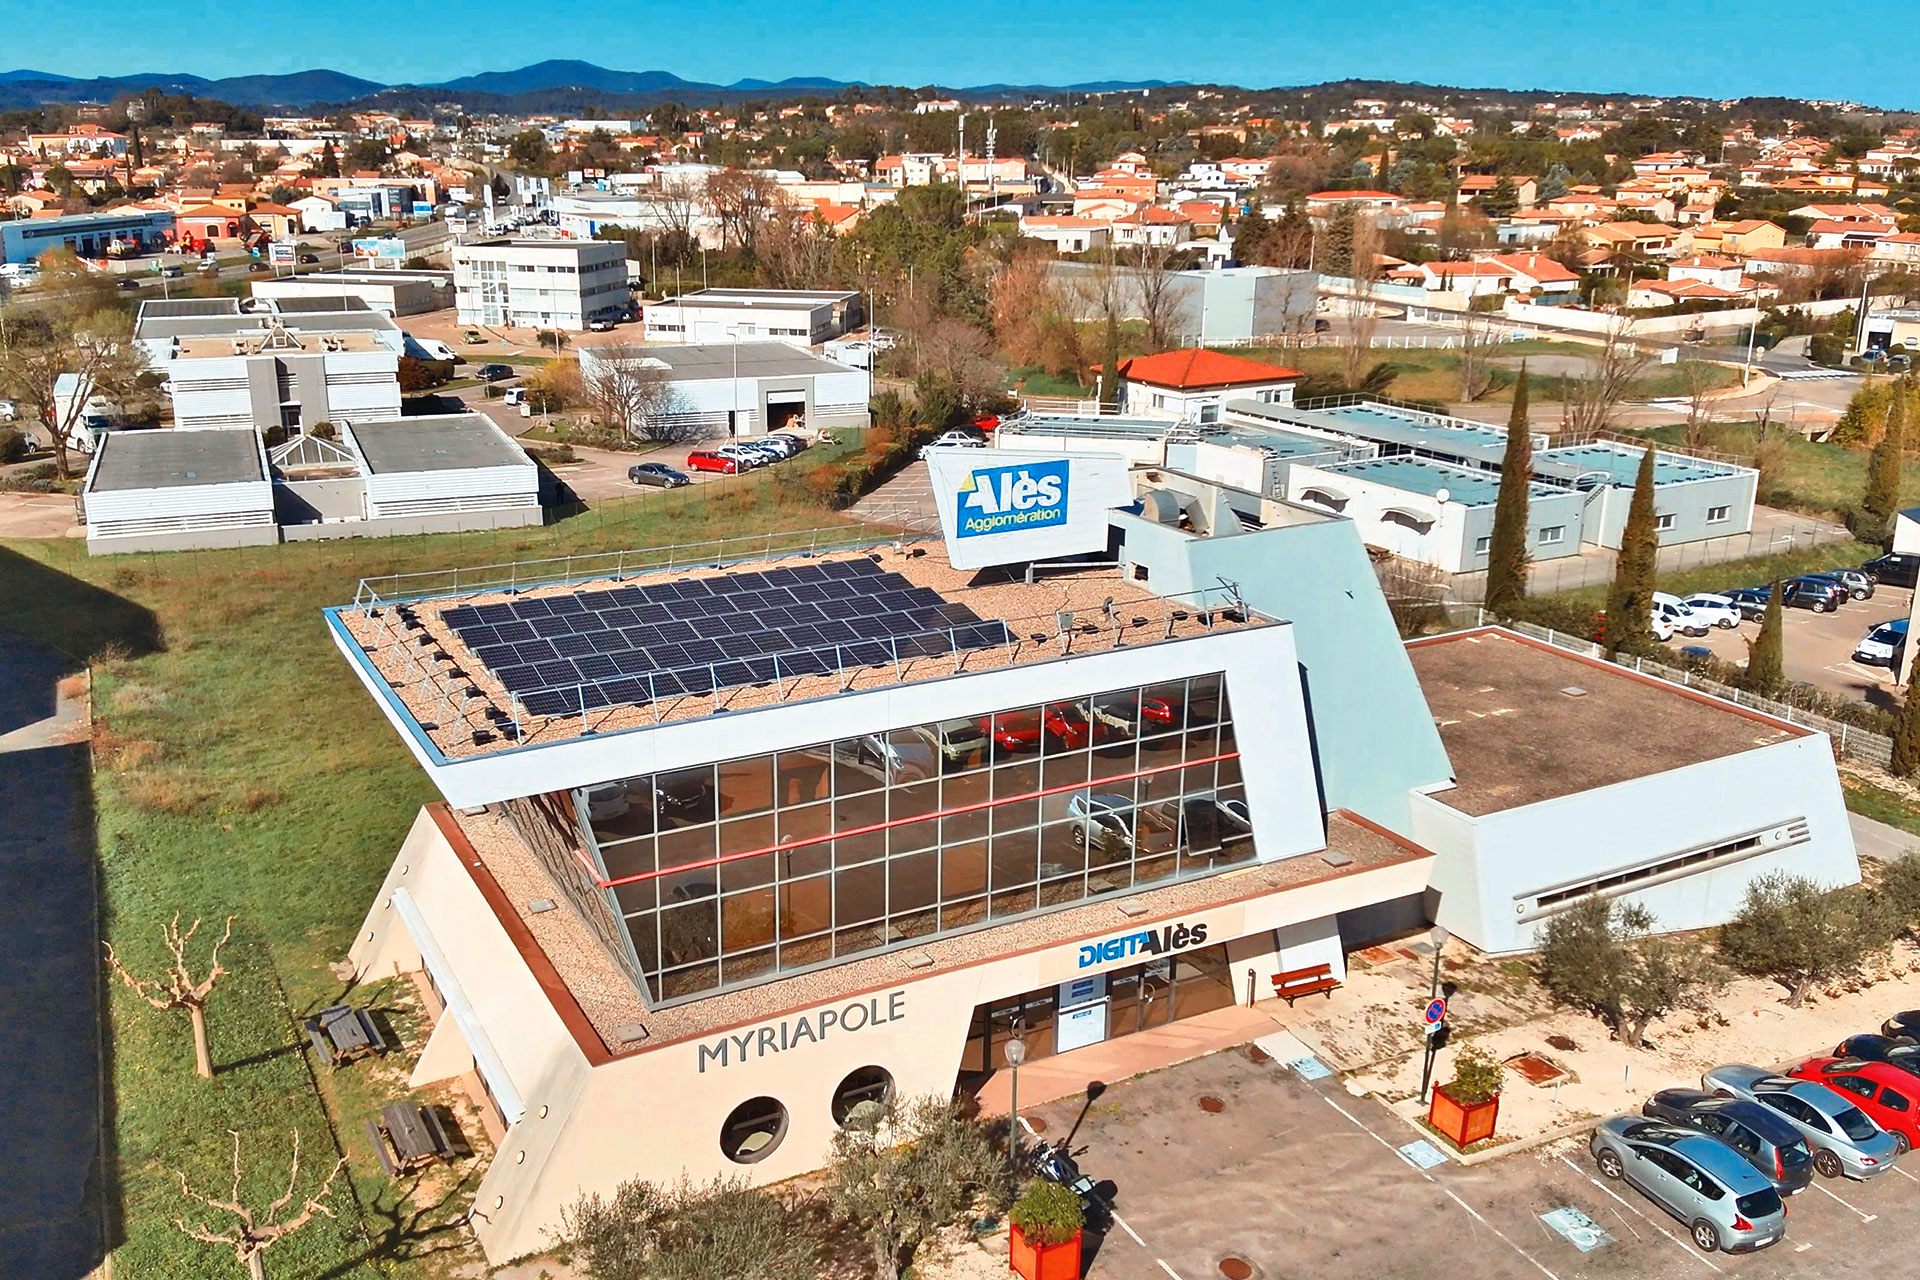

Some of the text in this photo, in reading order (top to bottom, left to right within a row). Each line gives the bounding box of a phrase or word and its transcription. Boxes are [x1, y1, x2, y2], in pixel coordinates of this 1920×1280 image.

[965, 471, 1062, 514] Alès
[965, 508, 1061, 532] Agglomération
[698, 990, 905, 1073] MYRIAPOLE
